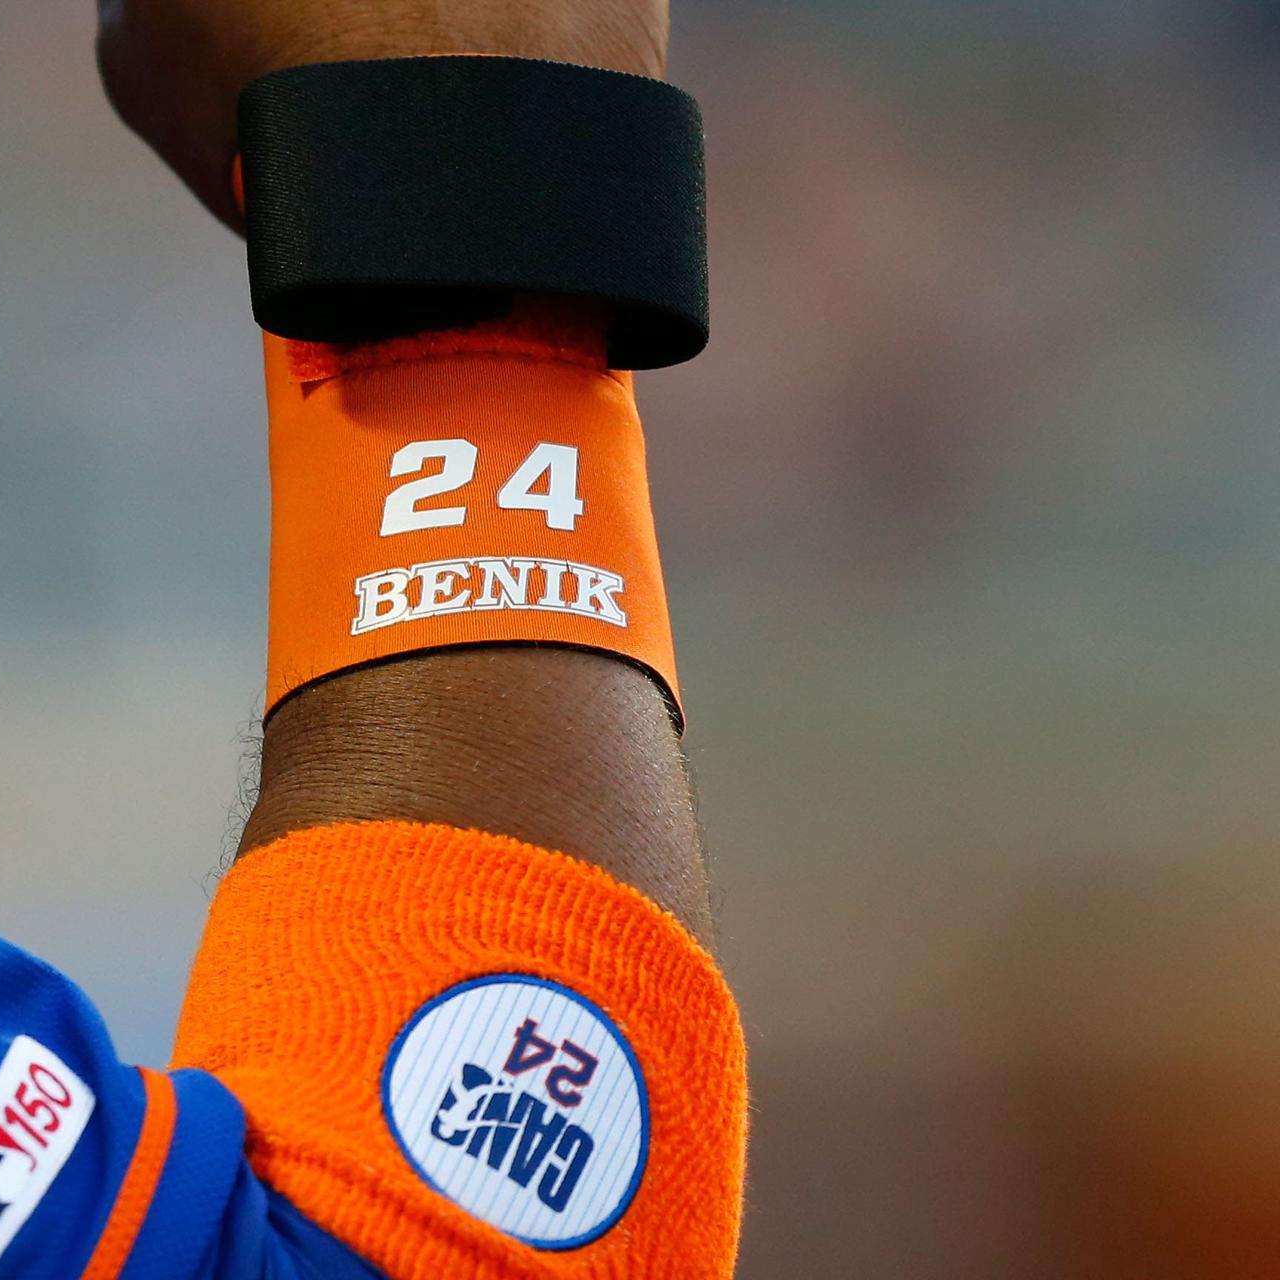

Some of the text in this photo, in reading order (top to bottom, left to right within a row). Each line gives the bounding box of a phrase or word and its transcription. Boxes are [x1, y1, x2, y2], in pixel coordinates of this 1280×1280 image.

[380, 438, 584, 536] 24
[351, 556, 628, 635] BENIK
[4, 1062, 72, 1148] 150
[503, 1018, 599, 1108] 24
